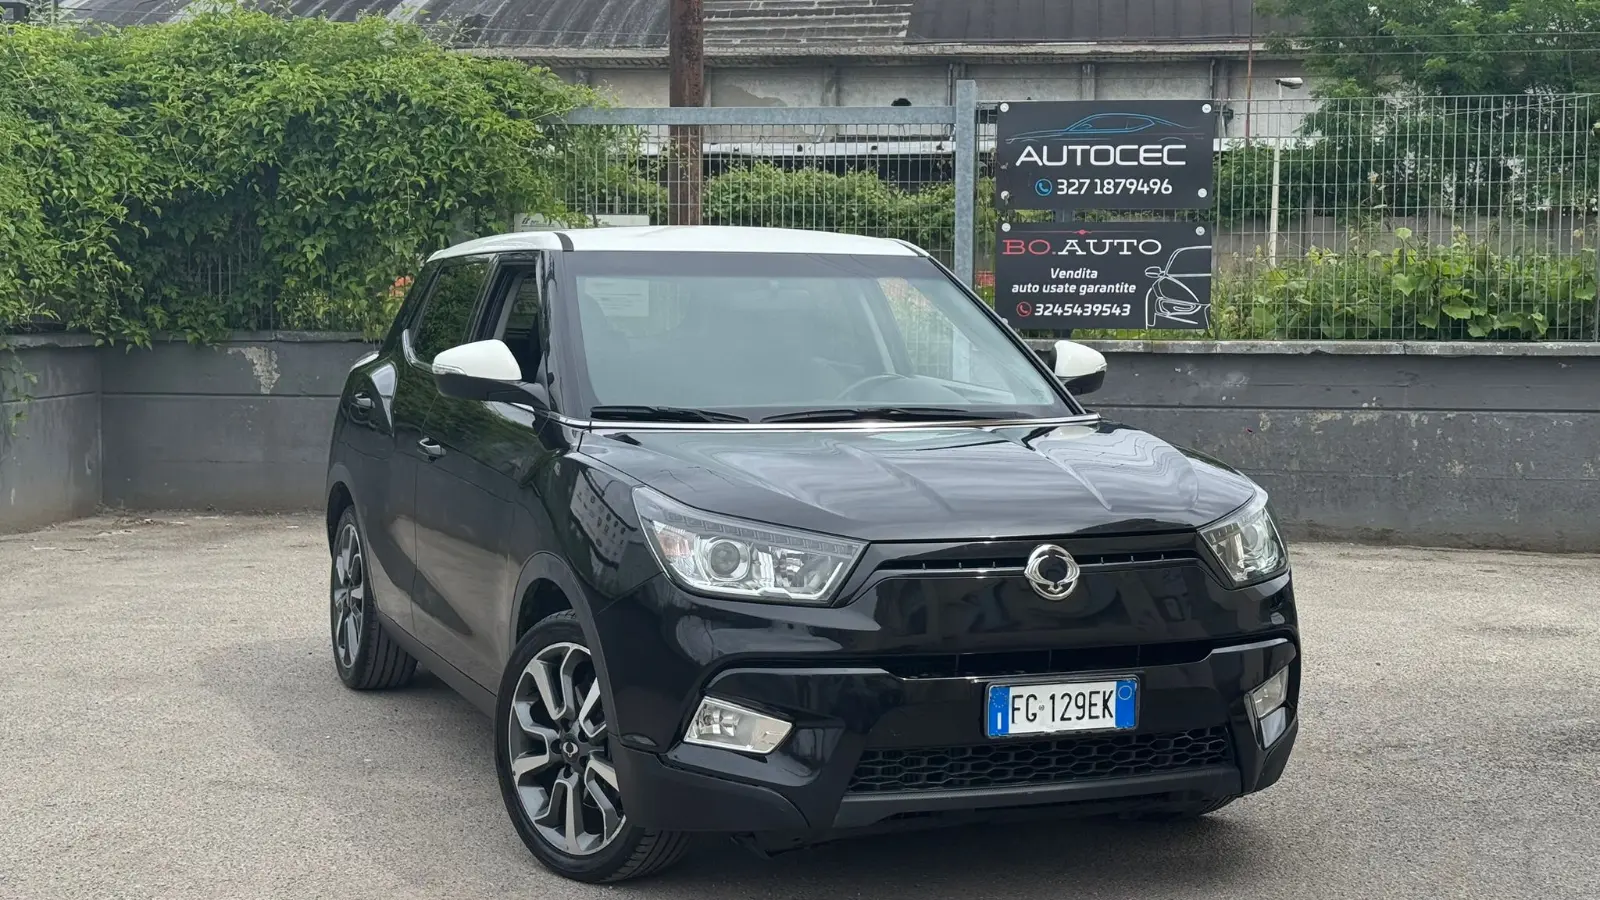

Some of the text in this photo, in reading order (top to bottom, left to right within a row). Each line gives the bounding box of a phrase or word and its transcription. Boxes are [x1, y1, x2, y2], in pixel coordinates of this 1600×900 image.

[1016, 144, 1187, 167] AUTOCEC
[1002, 239, 1162, 255] BO.AUTO
[1050, 267, 1098, 279] Vendita
[1011, 282, 1137, 296] auto usate garantite
[1034, 303, 1131, 316] 3245439543
